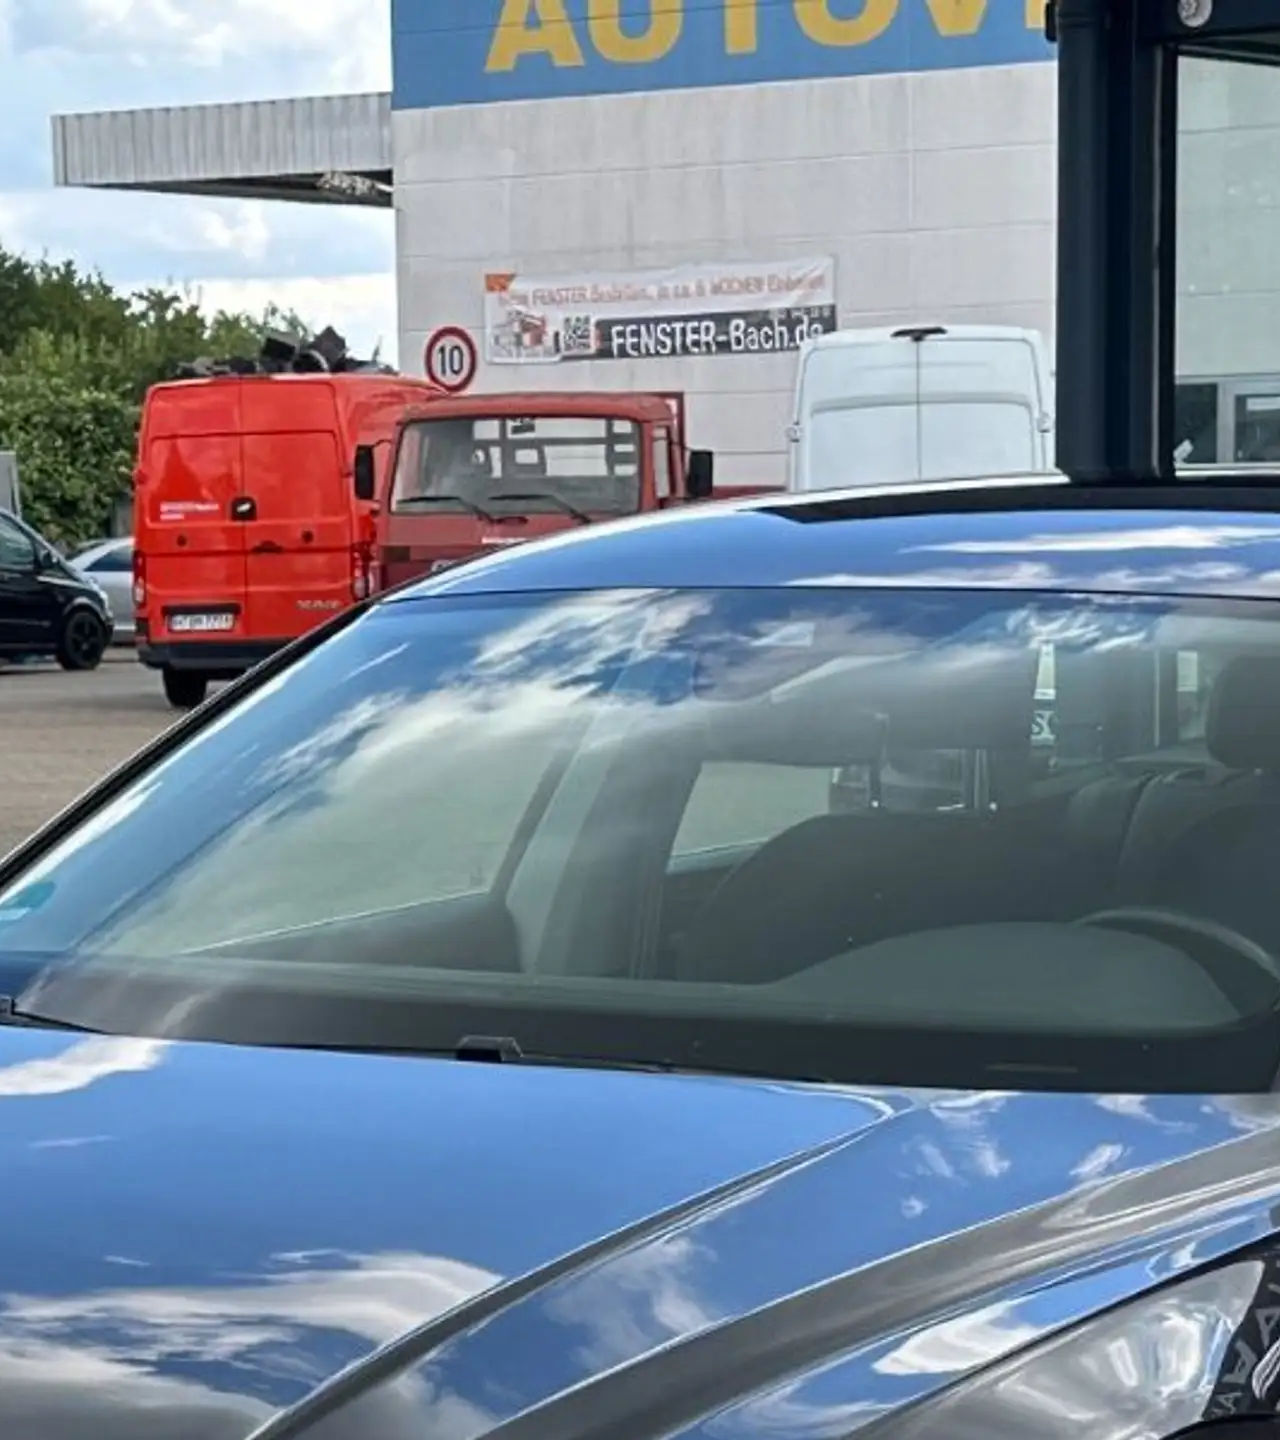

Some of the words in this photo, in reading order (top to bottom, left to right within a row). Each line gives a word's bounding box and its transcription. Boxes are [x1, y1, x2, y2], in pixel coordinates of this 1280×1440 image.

[484, 0, 1045, 73] AUTO
[611, 314, 824, 357] FENSTER-Bach.de
[438, 343, 464, 376] 10
